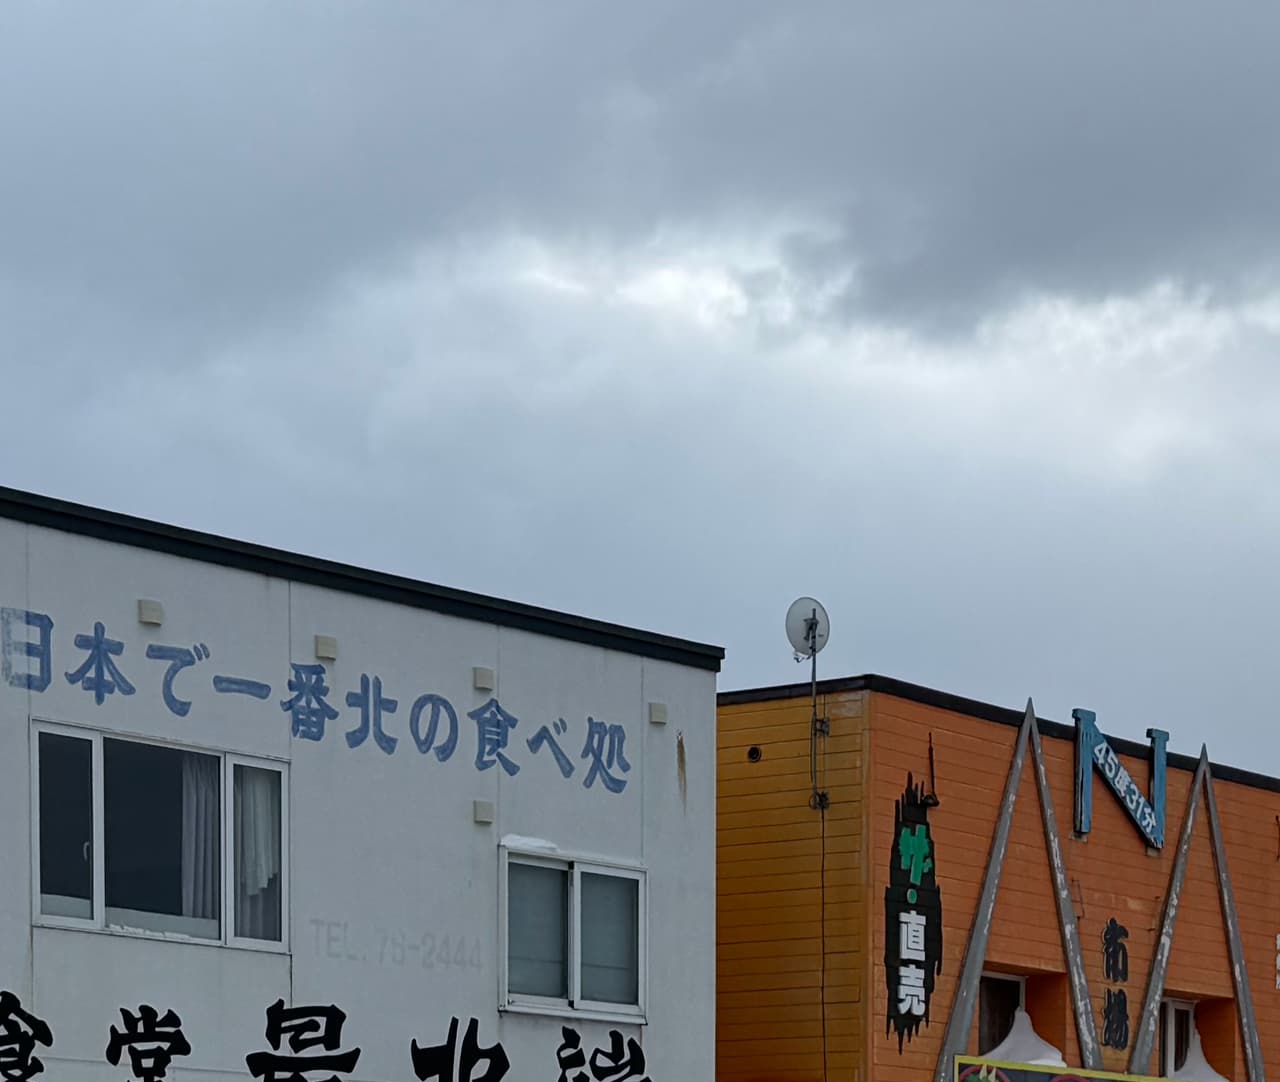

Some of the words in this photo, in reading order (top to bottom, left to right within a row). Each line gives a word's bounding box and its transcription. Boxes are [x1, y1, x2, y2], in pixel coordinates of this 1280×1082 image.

[0, 607, 632, 794] 日本で一番北の食べ処
